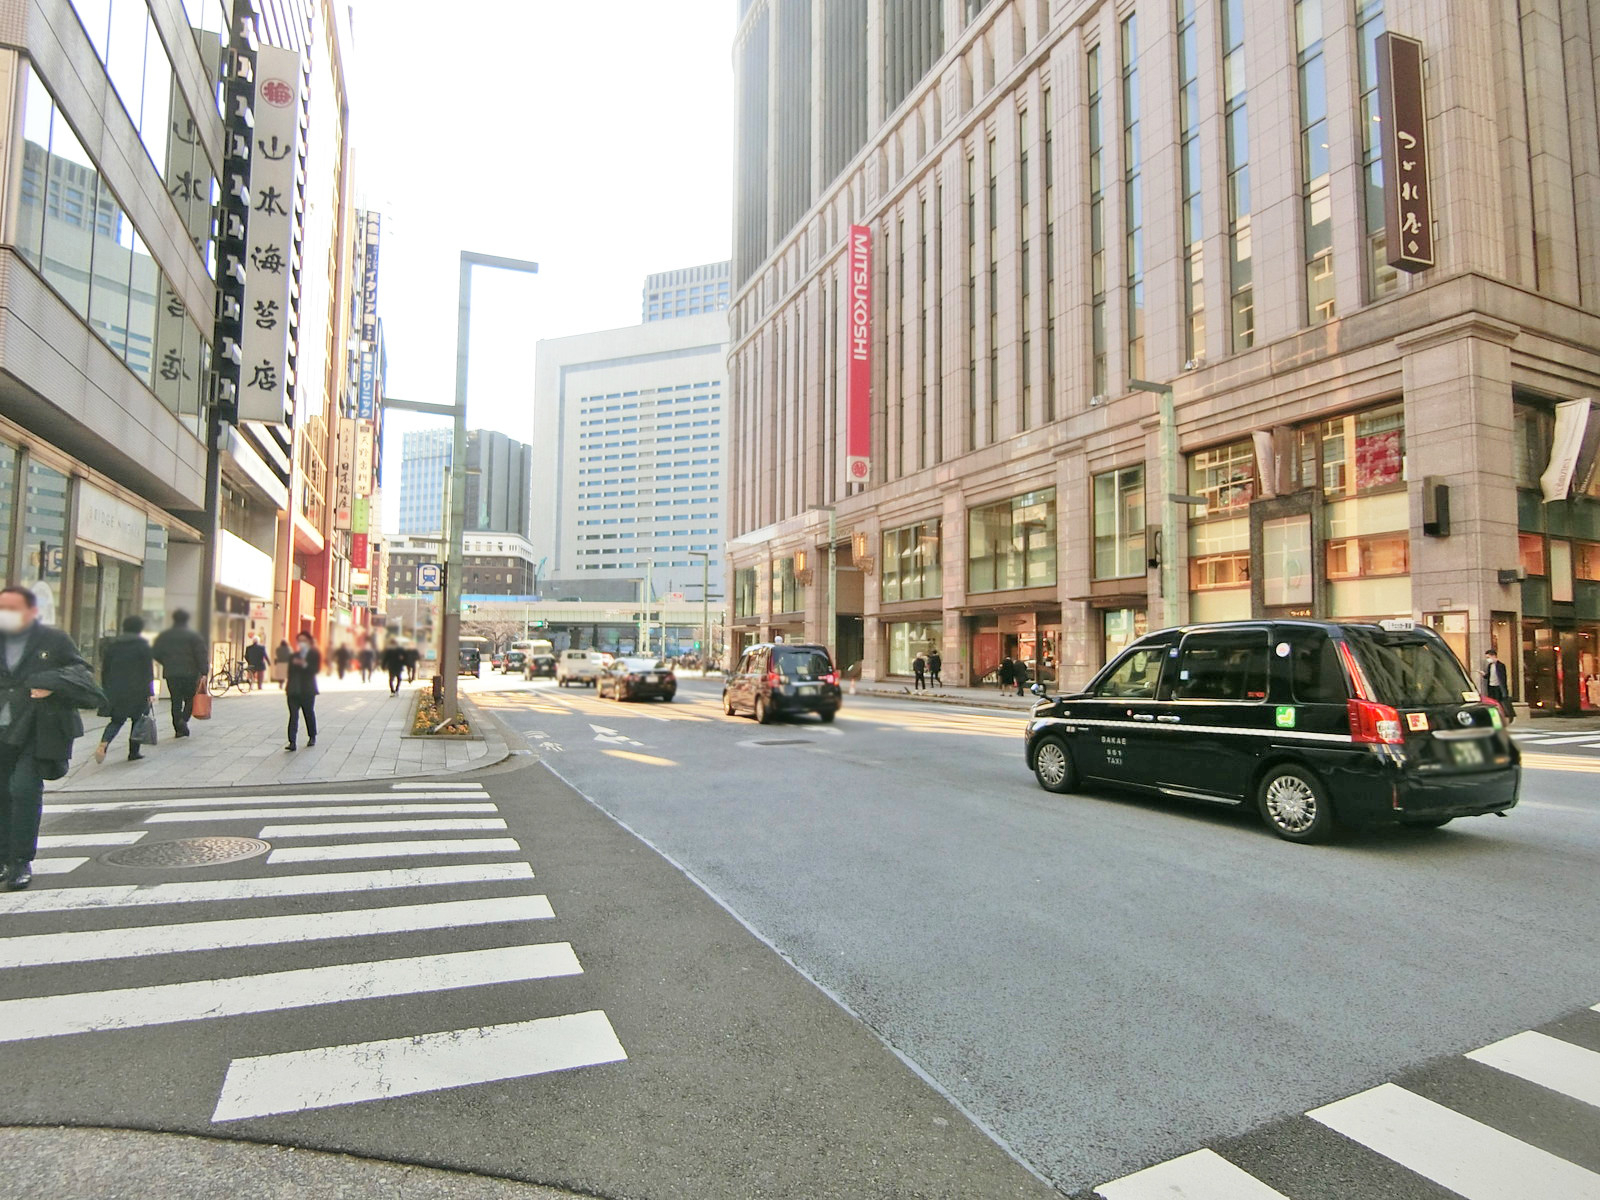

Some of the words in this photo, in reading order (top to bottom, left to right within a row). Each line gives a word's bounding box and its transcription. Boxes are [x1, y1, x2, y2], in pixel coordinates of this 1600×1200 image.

[247, 135, 291, 391] 山本海苔店
[853, 234, 868, 361] MITSUKOSHI
[1106, 757, 1123, 765] TAXI
